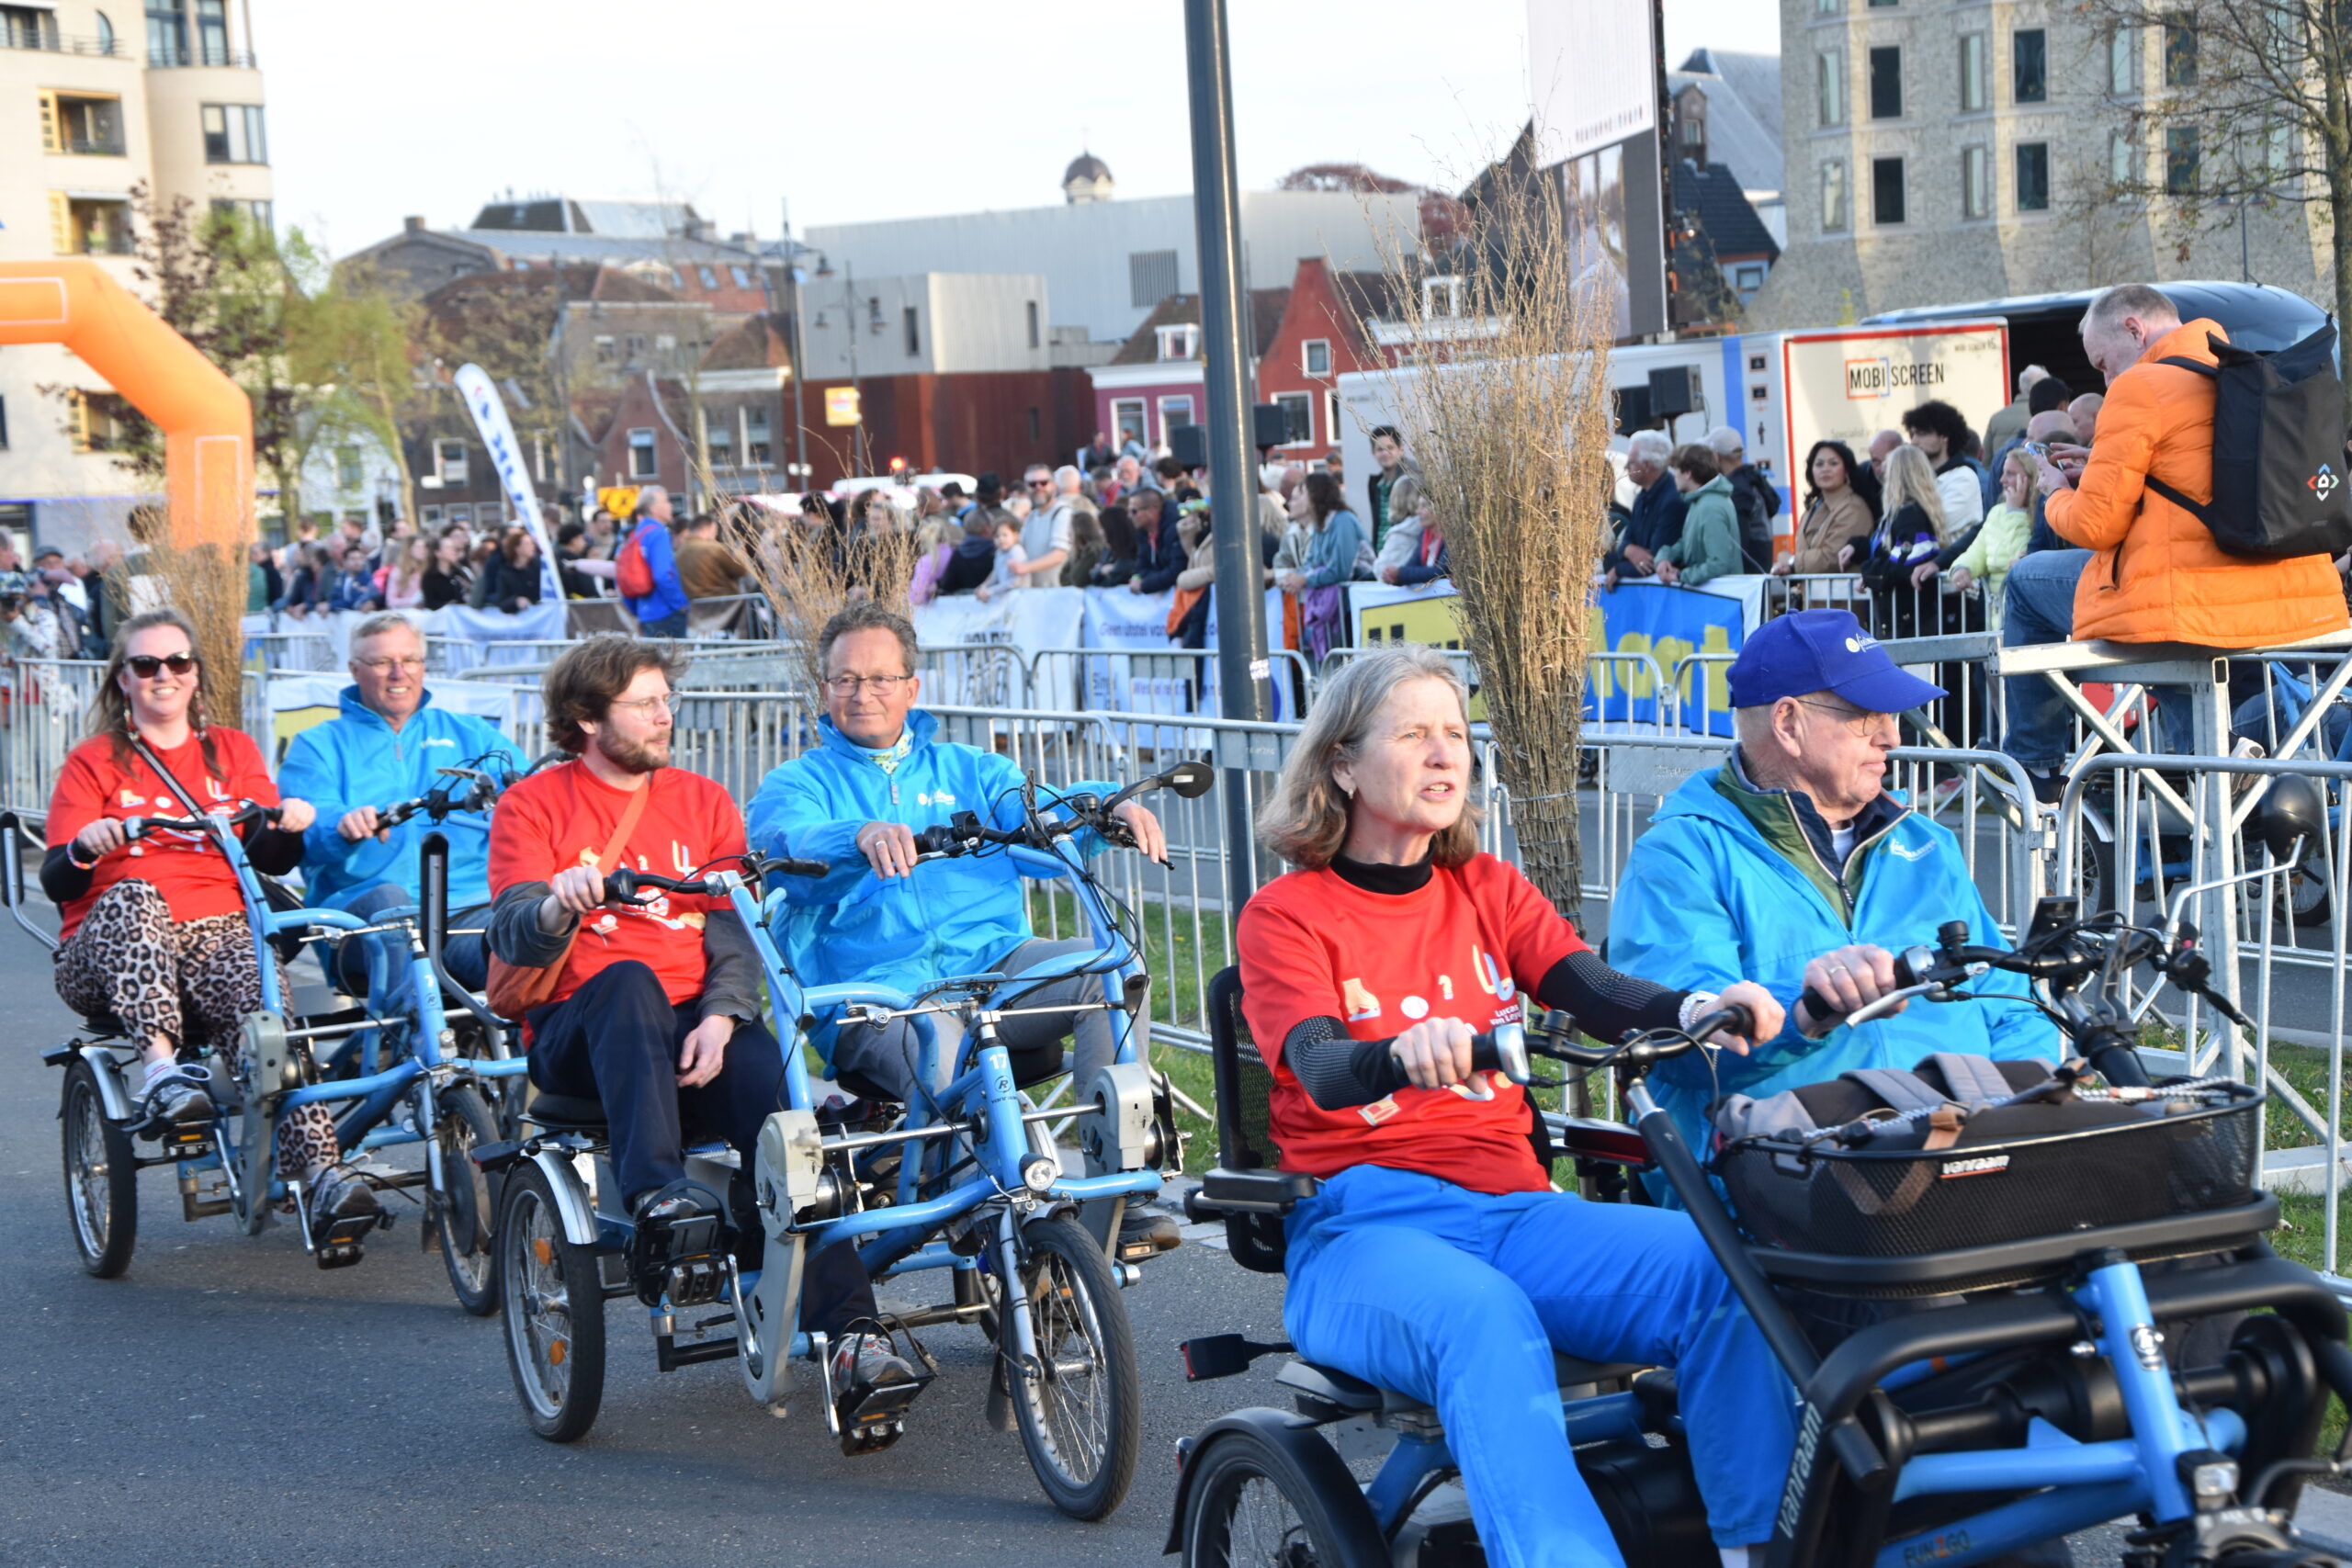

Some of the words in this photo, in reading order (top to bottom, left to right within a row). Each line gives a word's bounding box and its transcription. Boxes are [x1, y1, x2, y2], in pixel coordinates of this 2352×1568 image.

[1849, 367, 1886, 389] MOBI
[1891, 363, 1945, 387] SCREEN
[1495, 1004, 1519, 1017] Lucas
[989, 1054, 1008, 1070] 17
[1942, 1156, 2010, 1174] vanraam
[1777, 1401, 1823, 1539] vanraam
